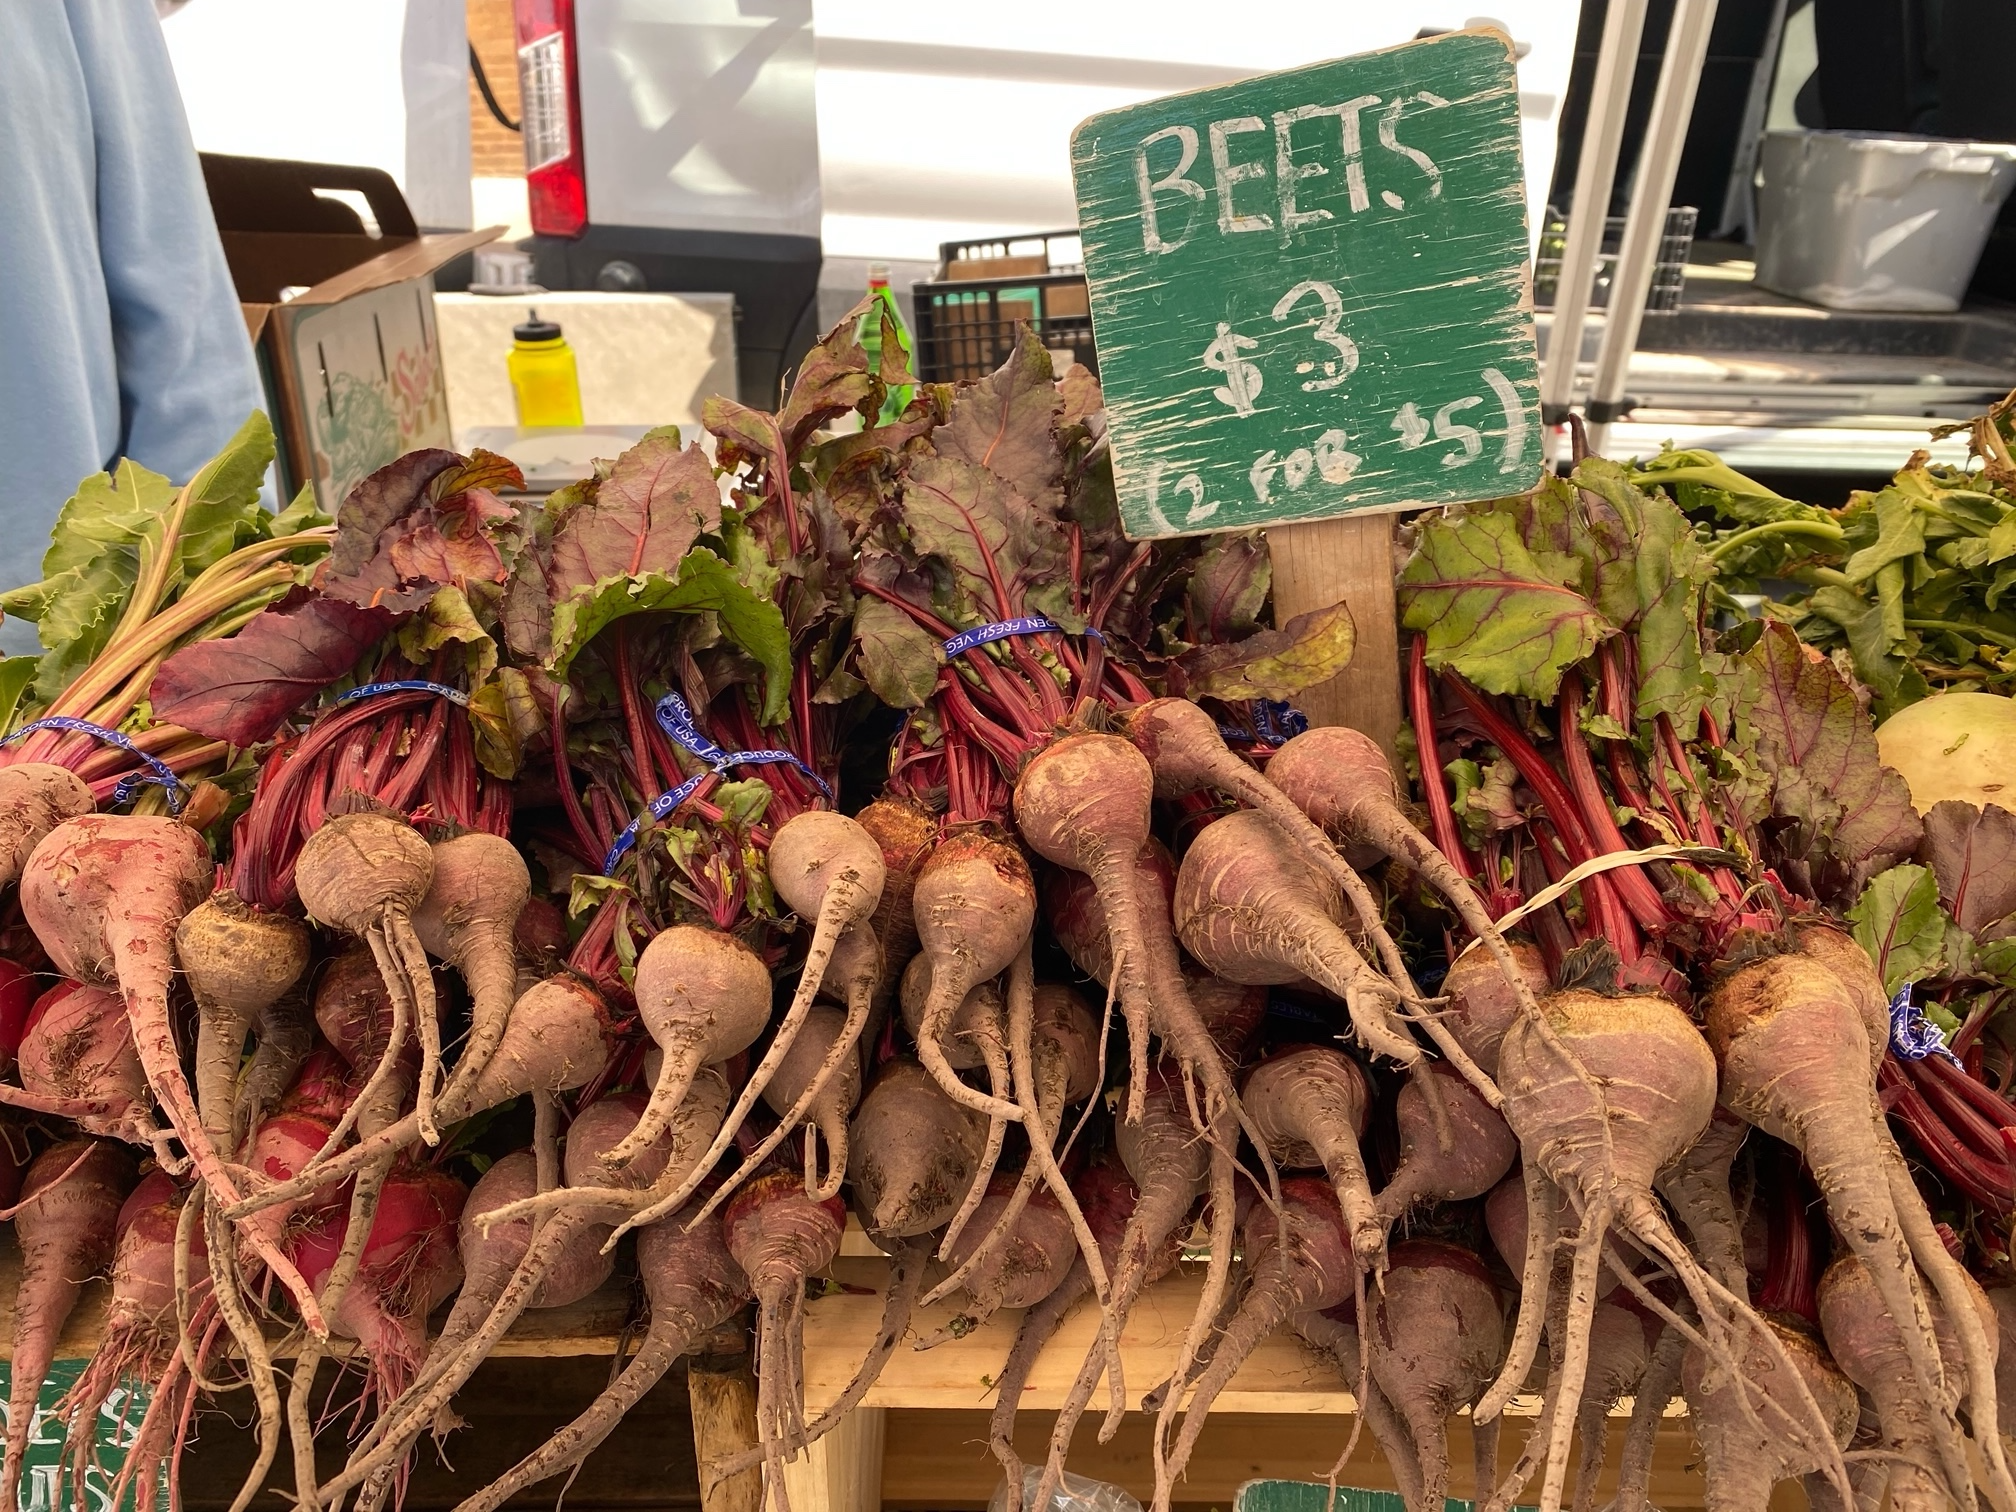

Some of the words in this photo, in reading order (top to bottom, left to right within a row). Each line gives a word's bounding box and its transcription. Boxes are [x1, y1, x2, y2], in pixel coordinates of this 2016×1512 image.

[1136, 91, 1450, 254] BEETS
[978, 621, 1021, 640] FRESH
[373, 683, 401, 692] USA
[64, 719, 114, 740] FRESH
[675, 726, 698, 746] USA
